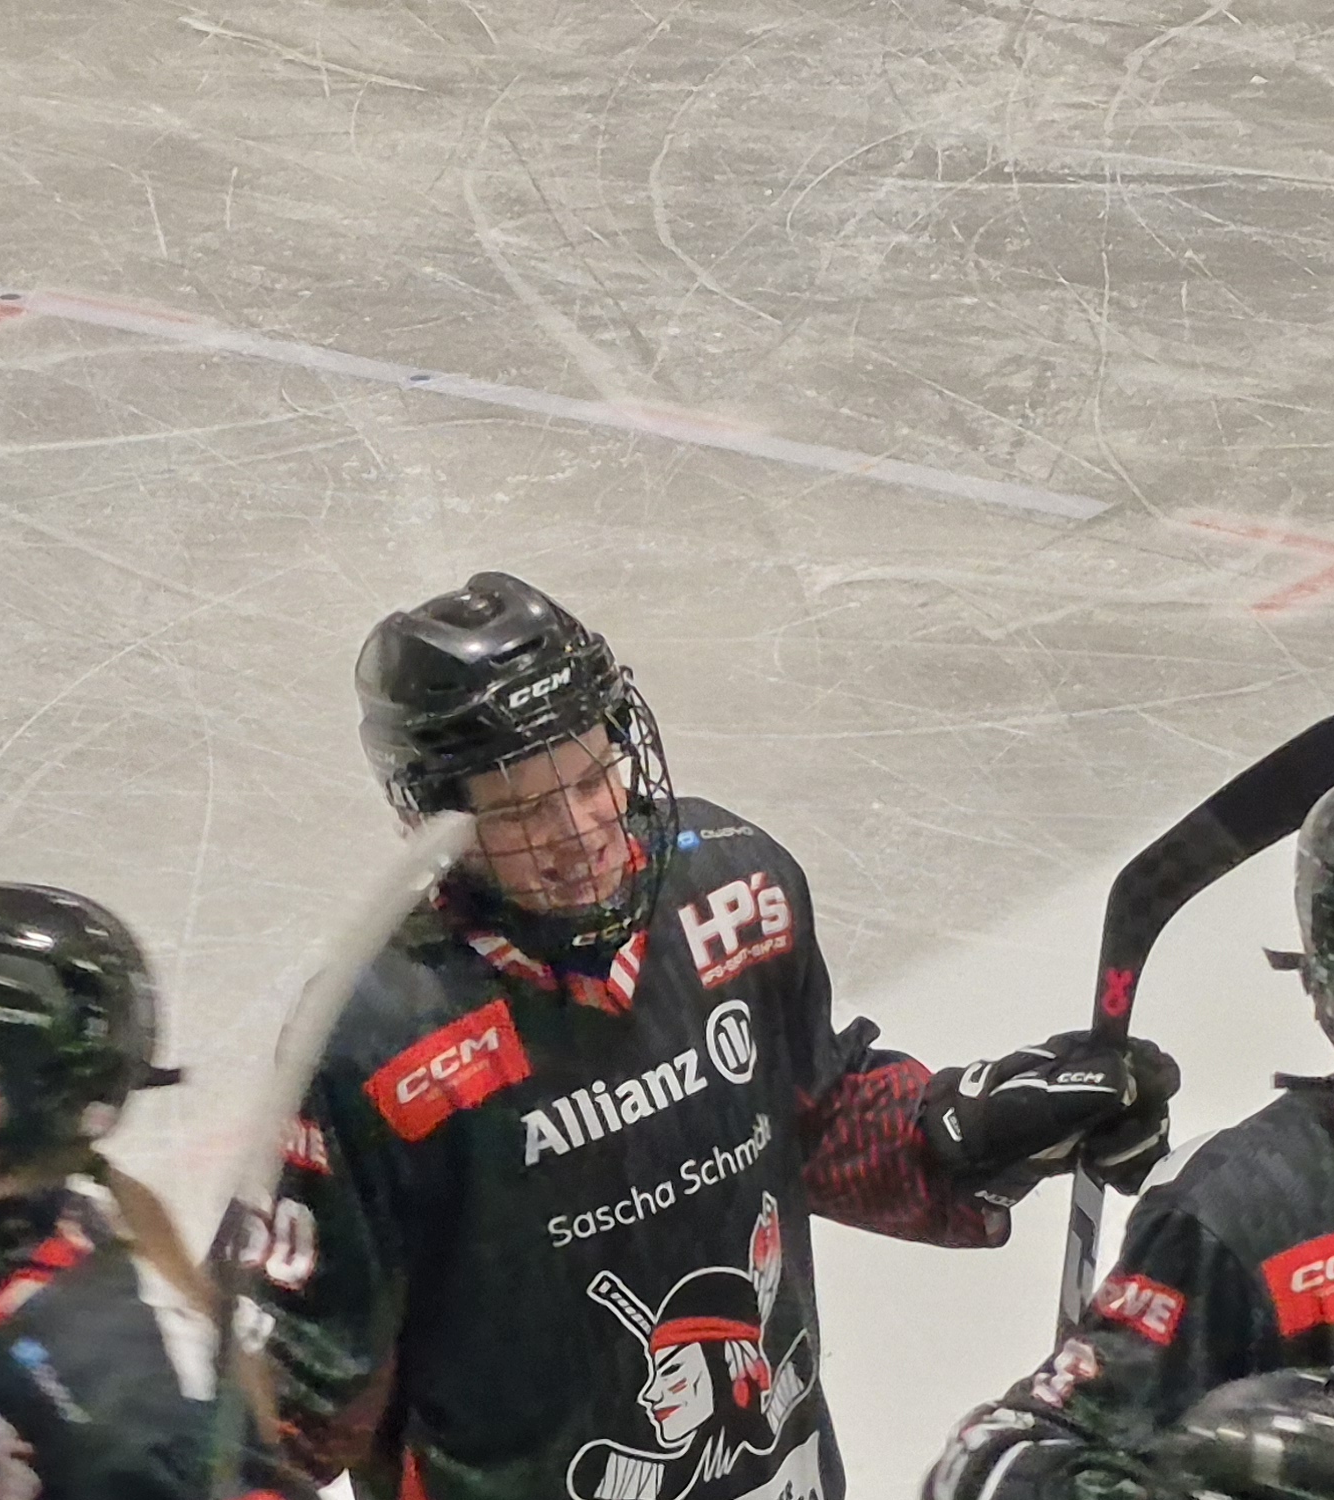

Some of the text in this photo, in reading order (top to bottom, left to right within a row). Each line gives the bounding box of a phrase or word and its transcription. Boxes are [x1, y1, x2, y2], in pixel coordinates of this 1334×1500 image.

[509, 667, 571, 708] CCM
[397, 1027, 499, 1104] CCM
[1057, 1072, 1105, 1084] CCM
[521, 1048, 708, 1167] Allianz
[548, 1181, 676, 1247] Sascha
